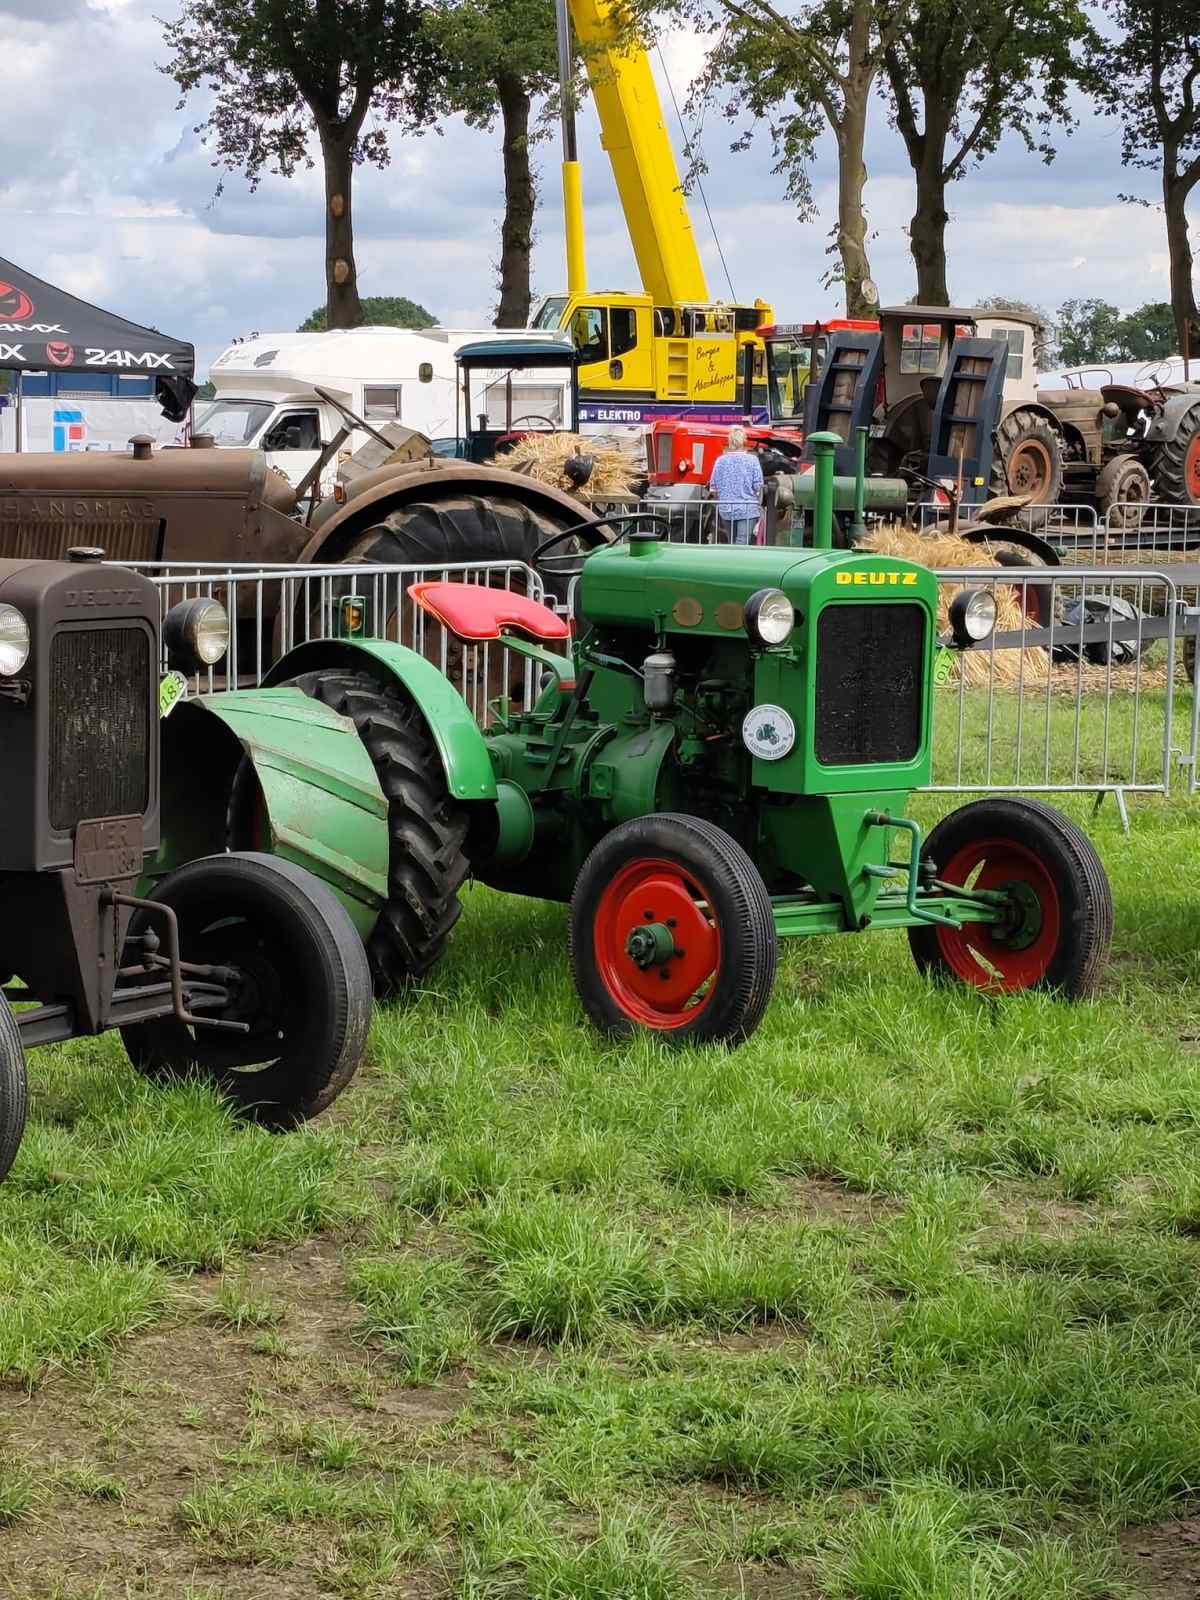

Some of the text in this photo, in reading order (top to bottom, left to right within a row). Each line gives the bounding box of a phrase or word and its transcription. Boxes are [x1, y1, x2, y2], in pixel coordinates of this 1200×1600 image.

[85, 348, 176, 369] 24MX
[598, 409, 641, 421] ELEKTRO
[836, 571, 918, 585] DEUTZ
[63, 589, 143, 608] DEUTZ
